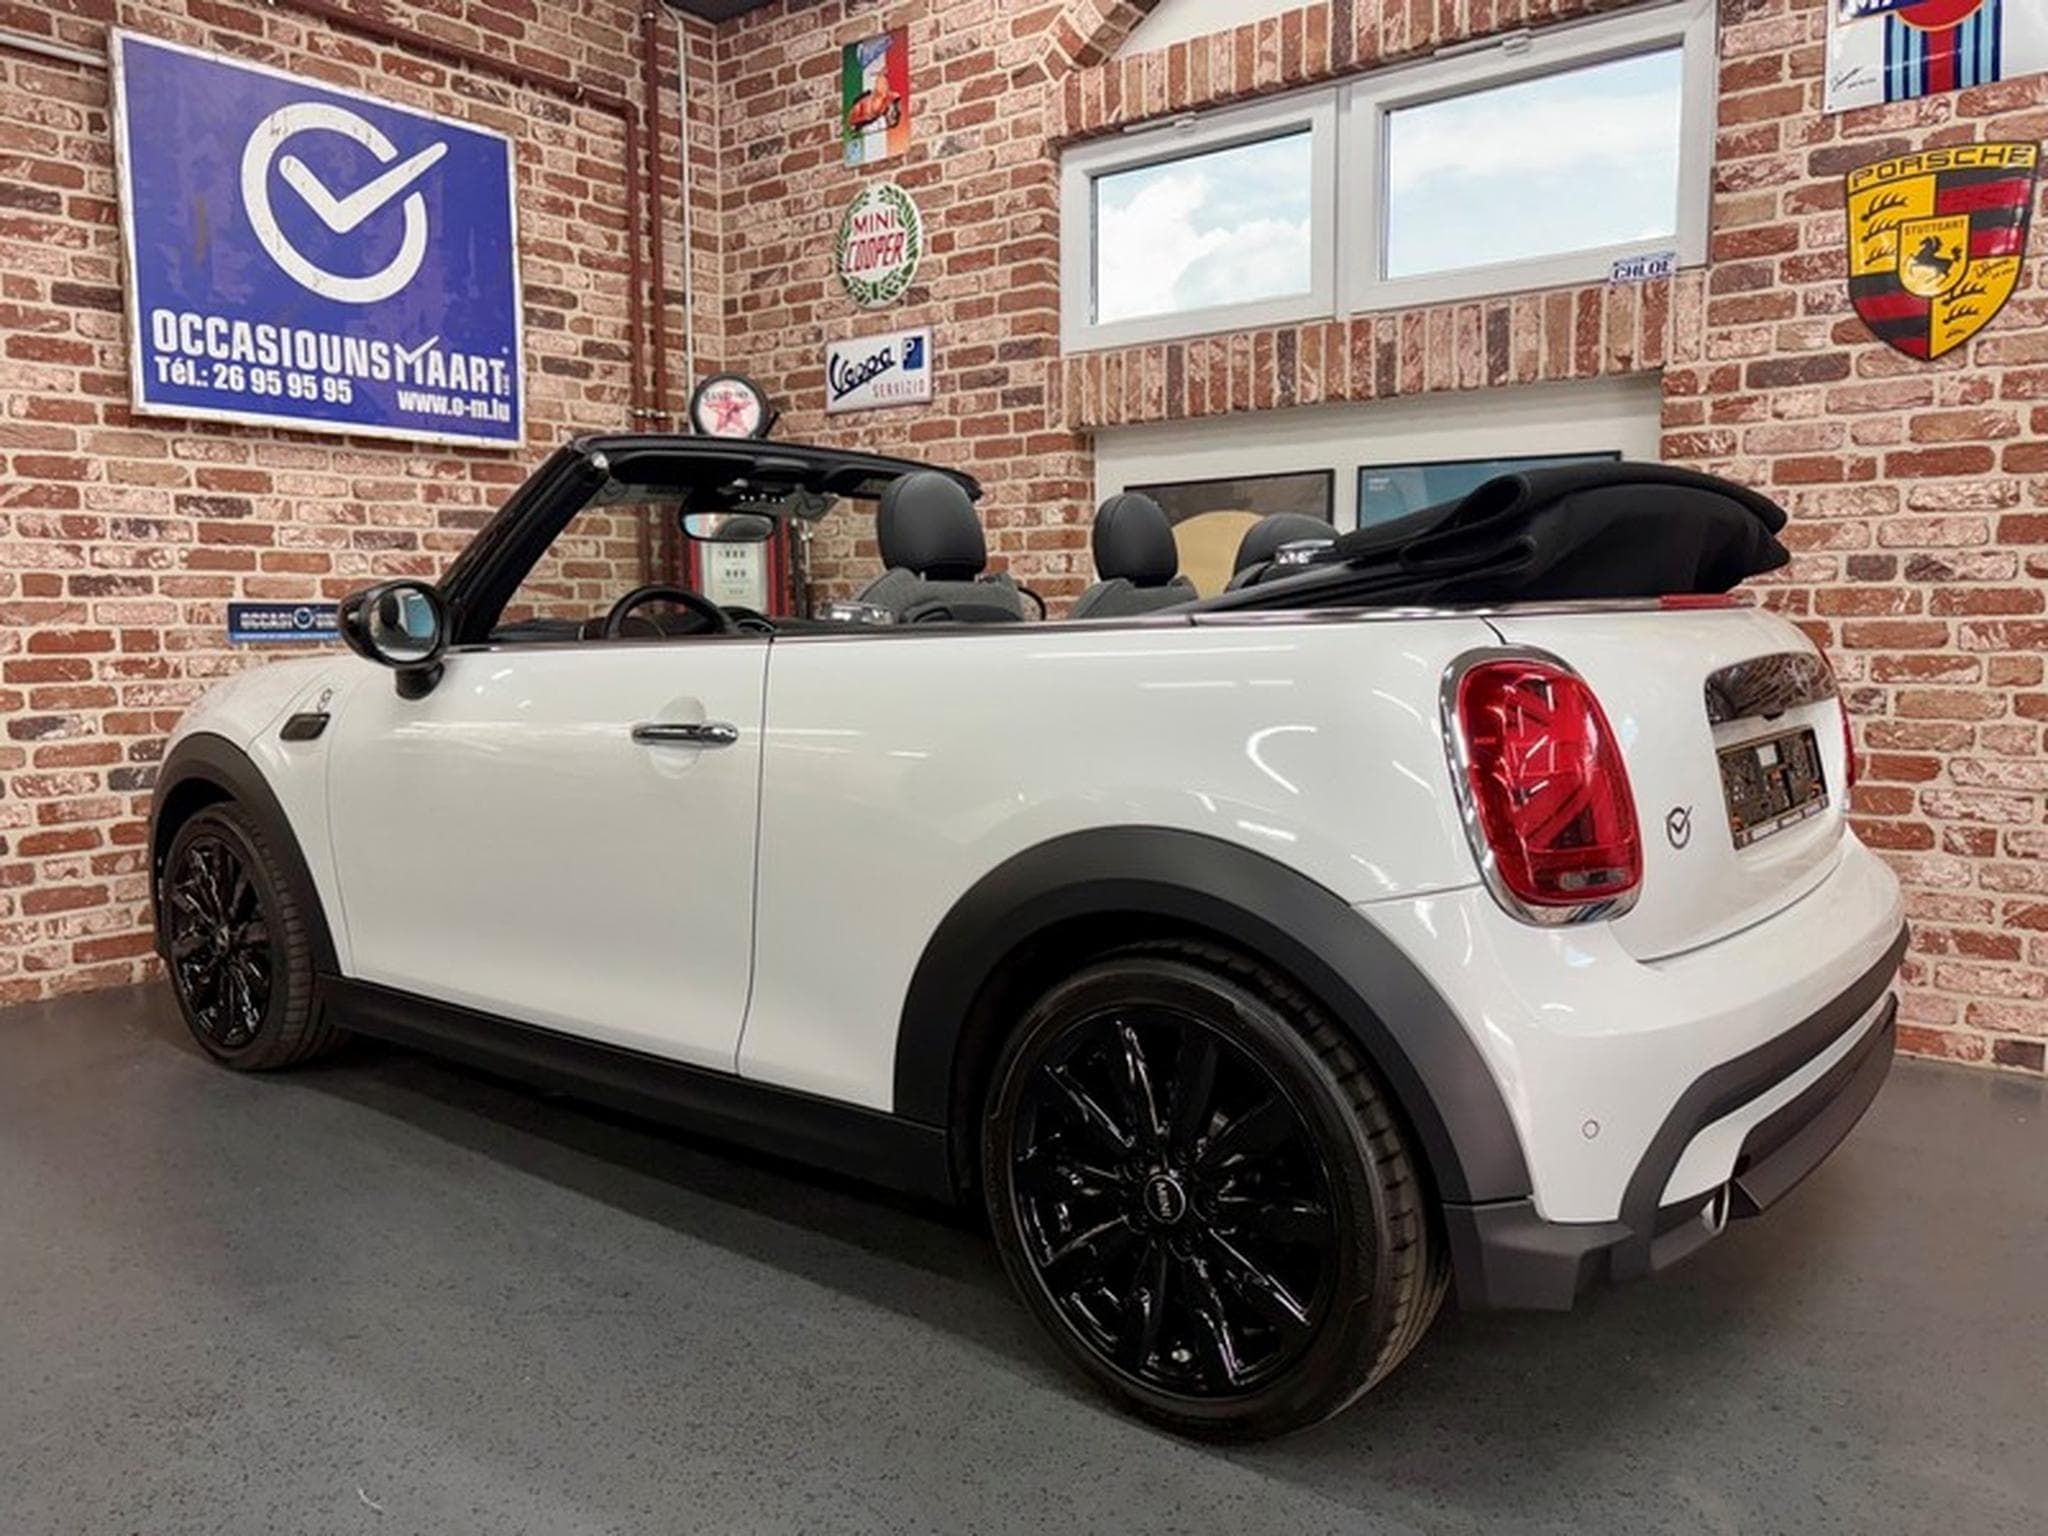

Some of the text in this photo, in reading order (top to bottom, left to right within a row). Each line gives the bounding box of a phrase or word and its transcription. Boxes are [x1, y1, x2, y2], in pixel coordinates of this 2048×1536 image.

[1852, 146, 2034, 188] PORSCHE
[854, 209, 895, 233] MINI
[1904, 218, 1966, 236] STUTTGART
[846, 231, 905, 272] COOPER
[154, 355, 353, 405] Tél.: 26 95 95 95
[829, 346, 896, 401] Vespa
[397, 389, 511, 423] www.o-m.lu
